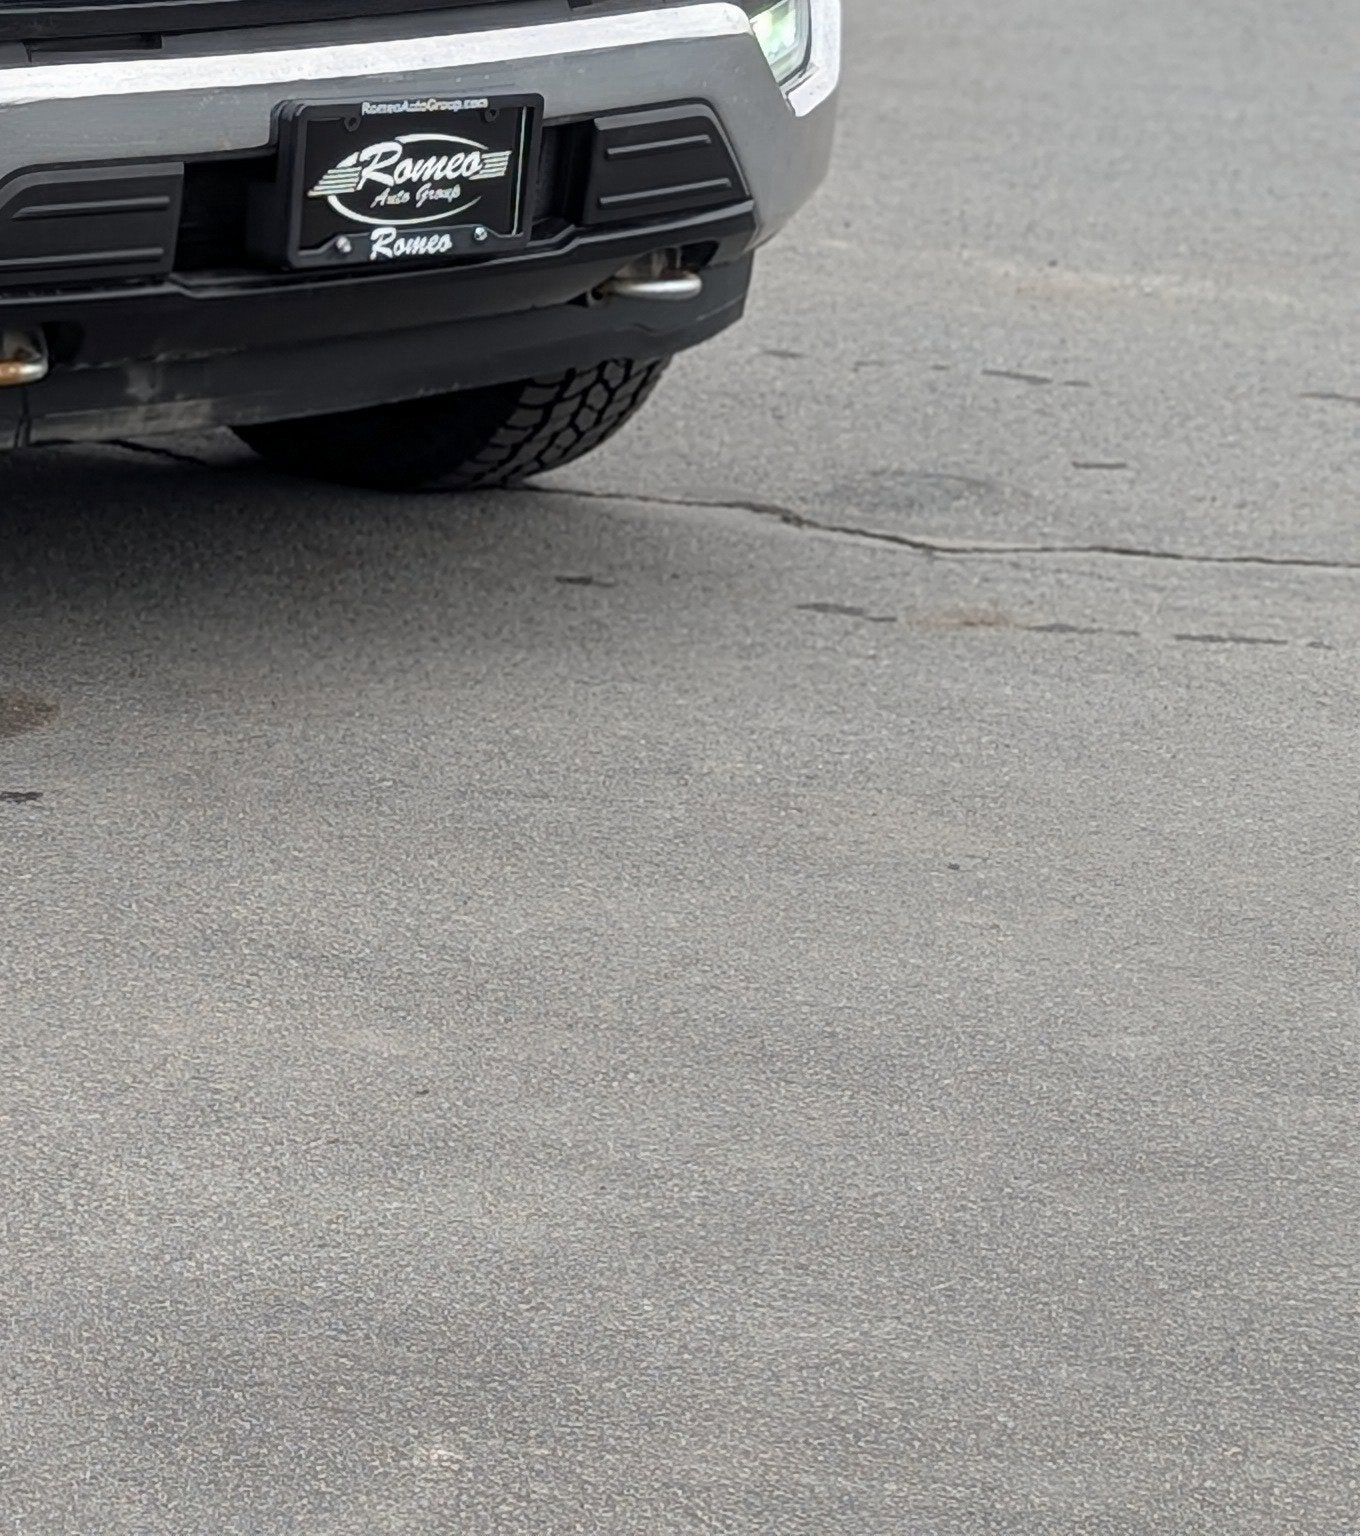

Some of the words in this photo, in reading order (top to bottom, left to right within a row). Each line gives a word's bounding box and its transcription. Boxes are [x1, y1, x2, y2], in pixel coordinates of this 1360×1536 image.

[356, 140, 482, 191] Romeo
[370, 187, 411, 208] Auto
[415, 183, 461, 208] Group
[369, 226, 452, 261] Romeo
